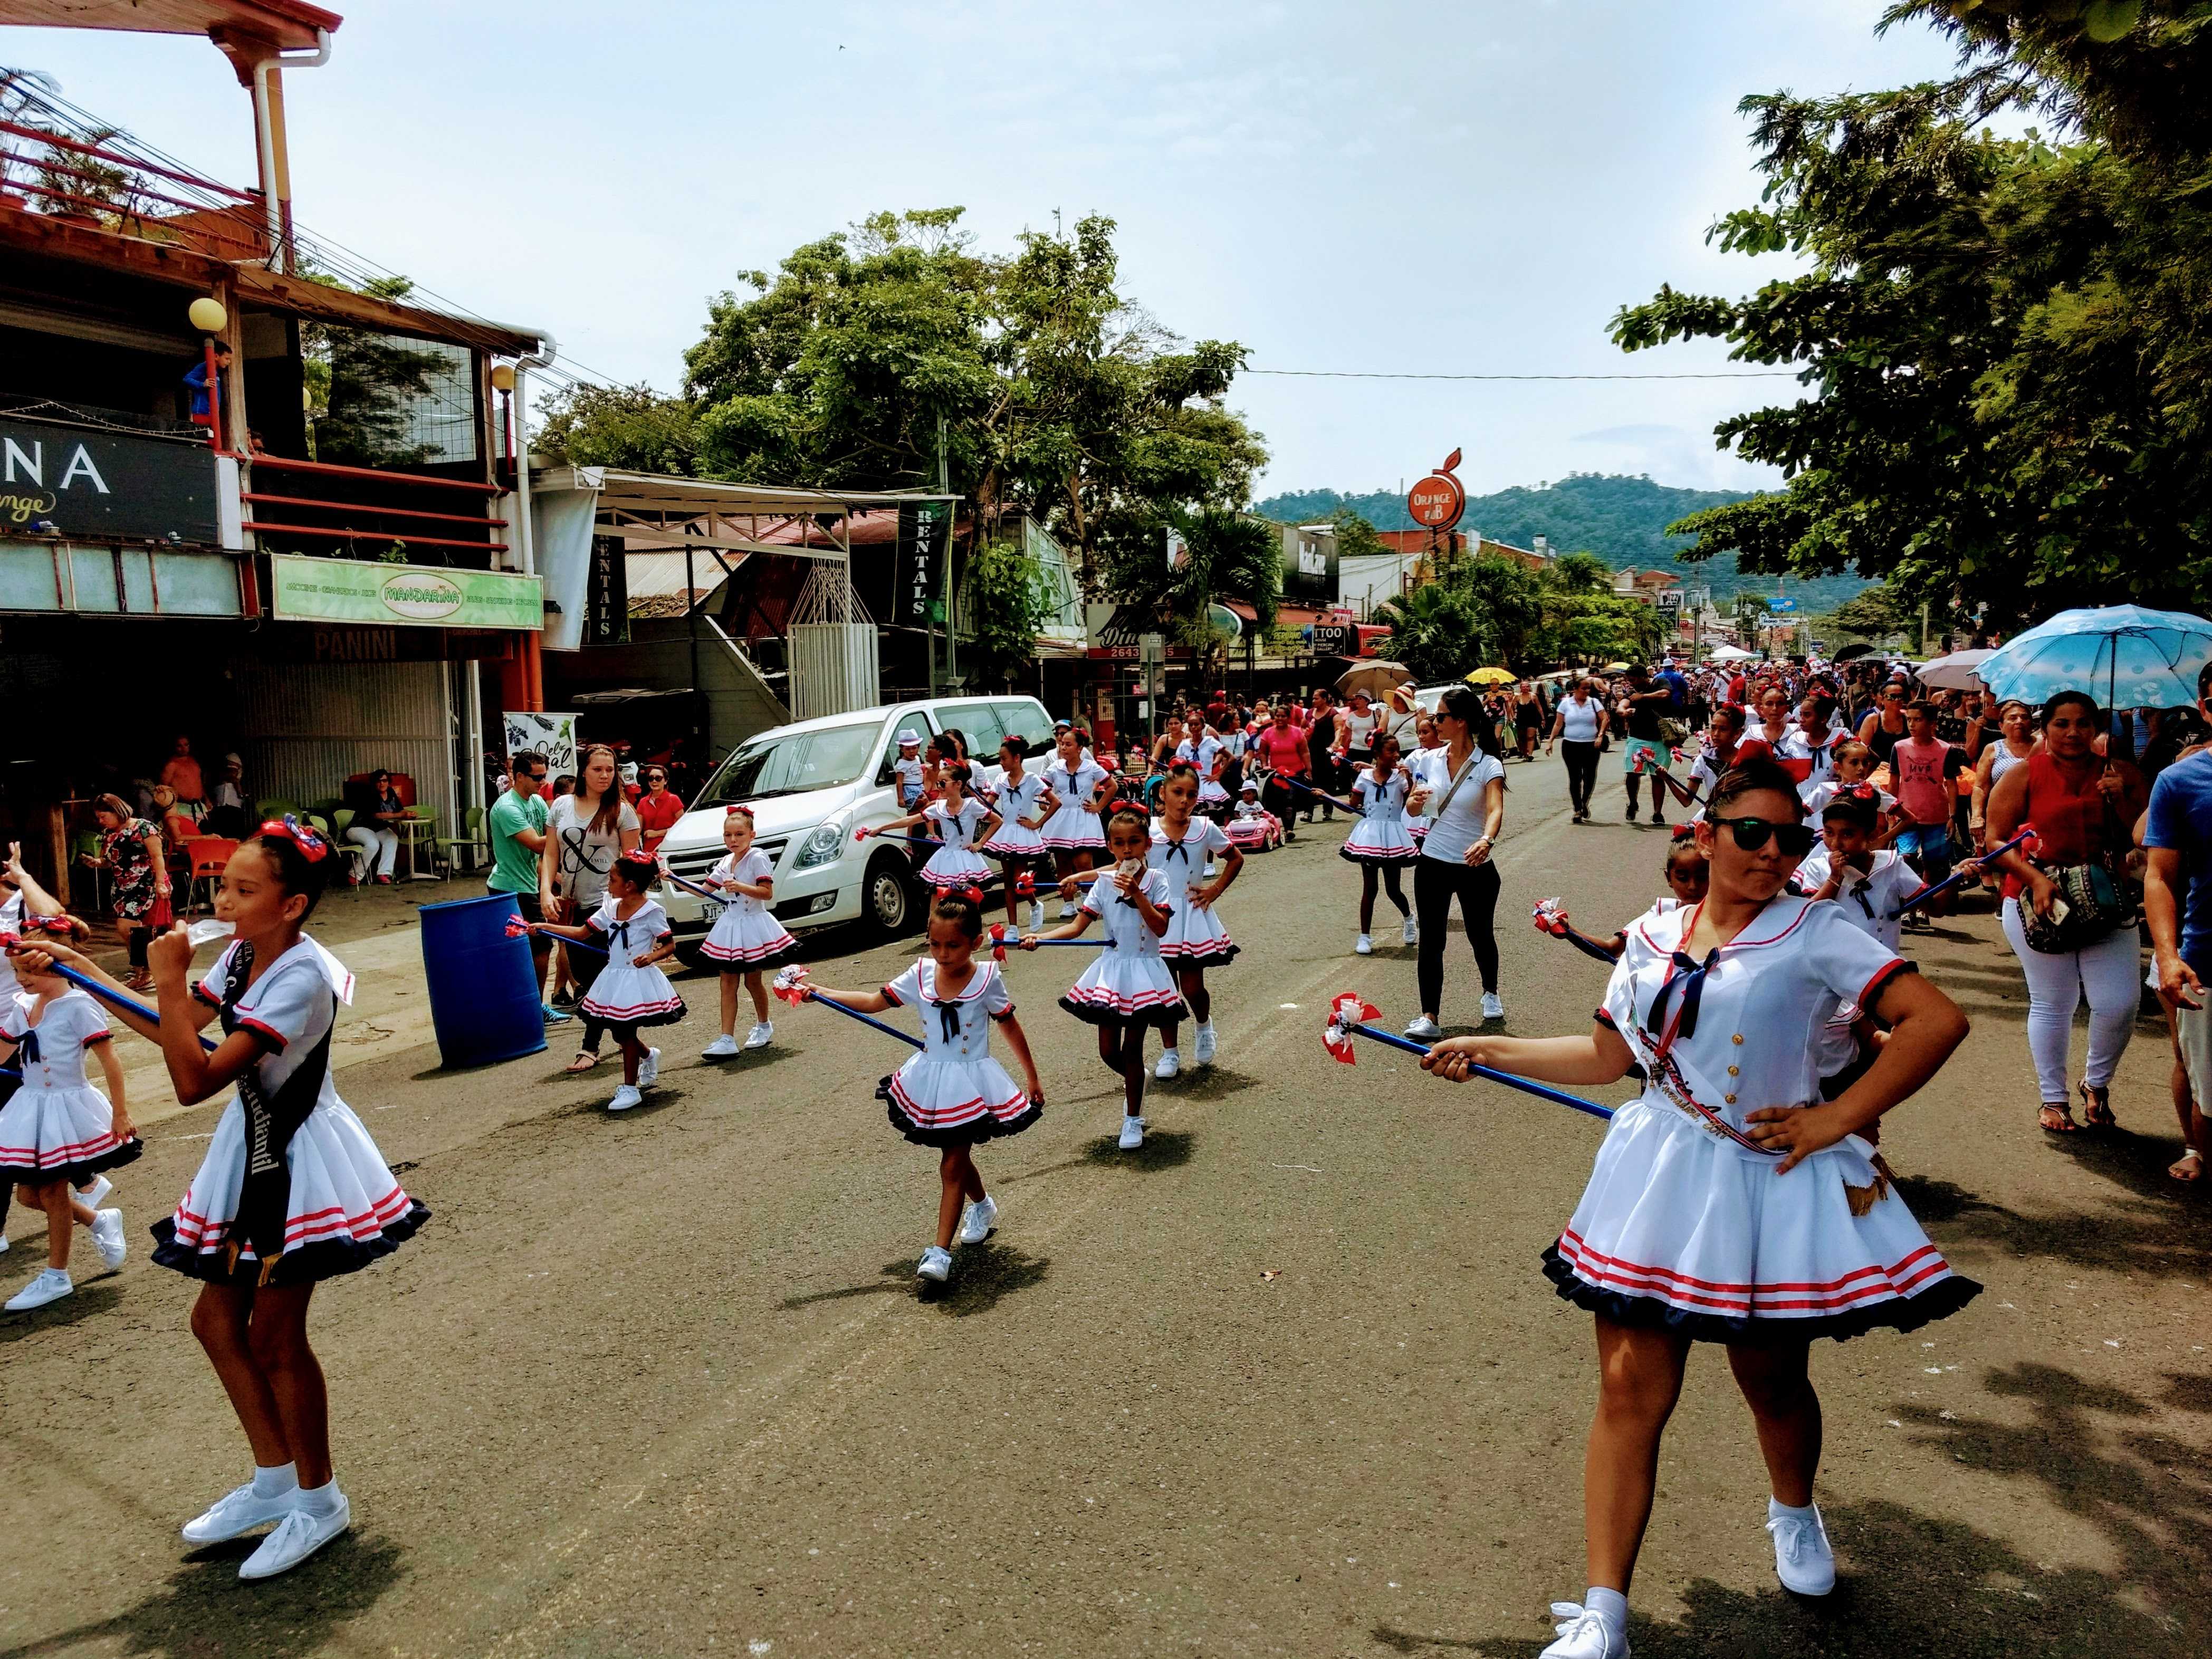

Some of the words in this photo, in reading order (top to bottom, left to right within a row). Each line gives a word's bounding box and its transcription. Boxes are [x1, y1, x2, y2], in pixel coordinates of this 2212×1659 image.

[3, 437, 111, 493] NA
[0, 491, 56, 522] nge
[1414, 493, 1451, 506] ORANGE
[1424, 505, 1443, 520] PUB
[913, 510, 933, 614] RENTALS
[384, 586, 459, 604] MANDARINA
[1315, 628, 1342, 638] TTOO
[315, 630, 397, 660] PANINI
[1909, 763, 1932, 773] MVP
[704, 906, 729, 919] BJT-1
[1702, 1118, 1735, 1140] 2017
